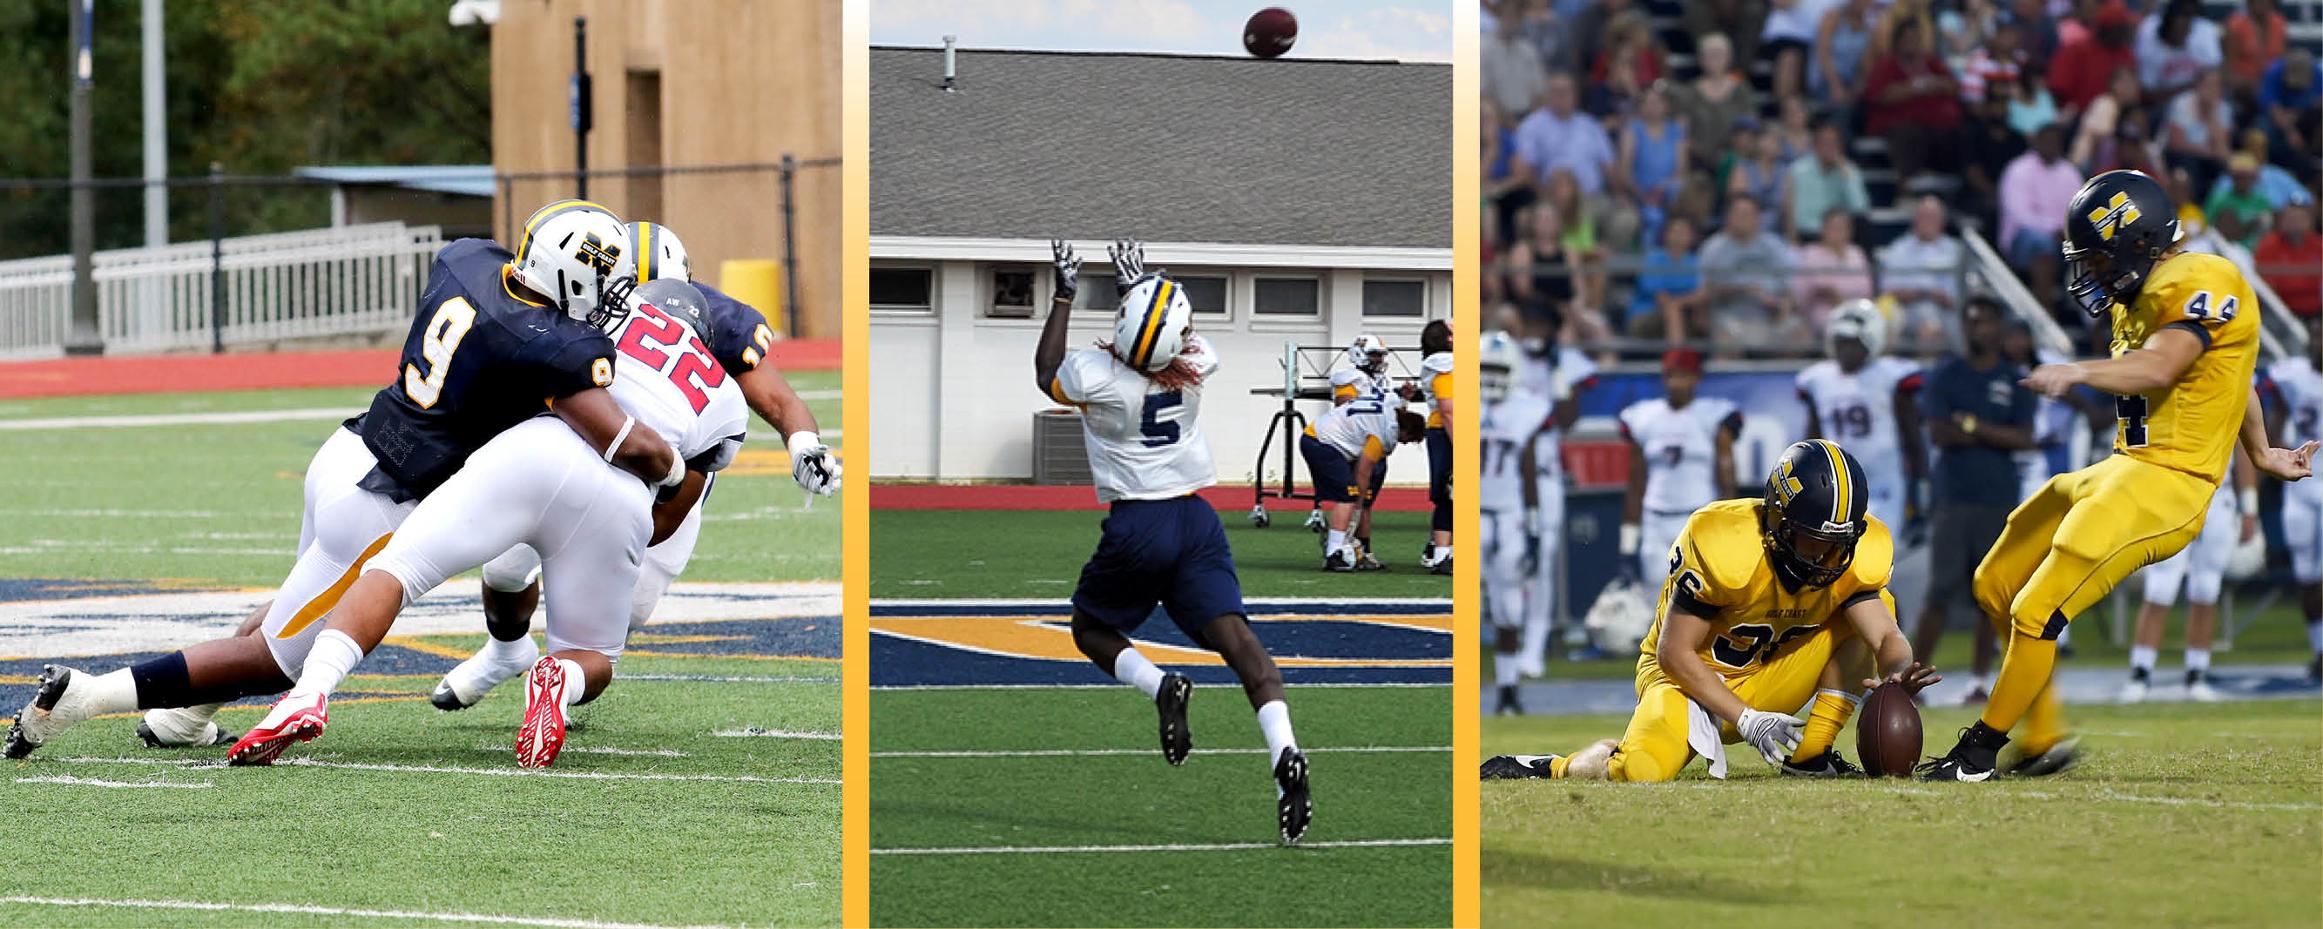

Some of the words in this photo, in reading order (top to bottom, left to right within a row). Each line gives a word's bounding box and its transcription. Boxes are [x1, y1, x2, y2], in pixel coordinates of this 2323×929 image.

[530, 259, 536, 268] 9
[582, 242, 599, 256] GULF
[597, 252, 616, 265] COAST
[666, 297, 680, 307] AW
[688, 304, 700, 319] 22
[2184, 290, 2239, 321] 44
[405, 295, 477, 410] 9
[616, 303, 727, 417] 22
[1140, 388, 1183, 449] 5
[1832, 403, 1872, 438] 19
